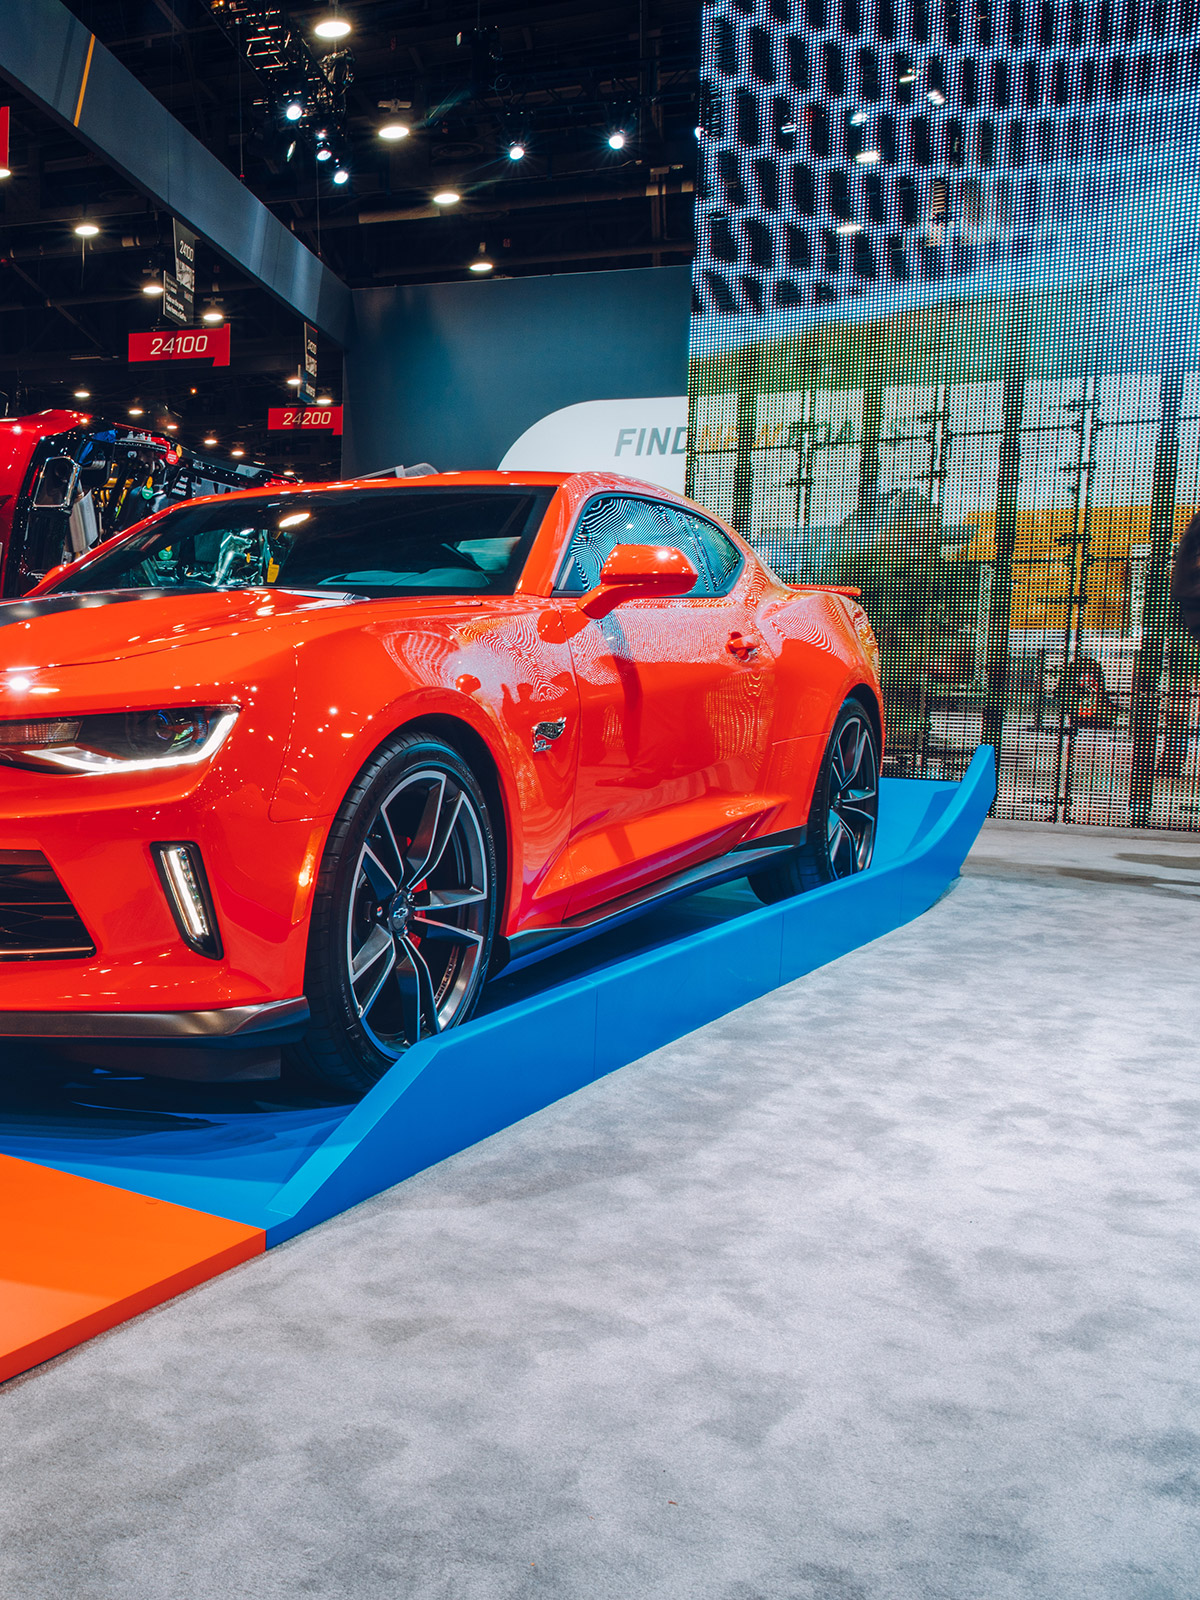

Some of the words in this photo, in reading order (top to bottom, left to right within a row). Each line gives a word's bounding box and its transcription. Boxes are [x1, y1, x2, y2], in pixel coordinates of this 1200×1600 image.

[150, 335, 208, 355] 24100
[283, 412, 331, 425] 24200
[614, 427, 688, 457] FIND
